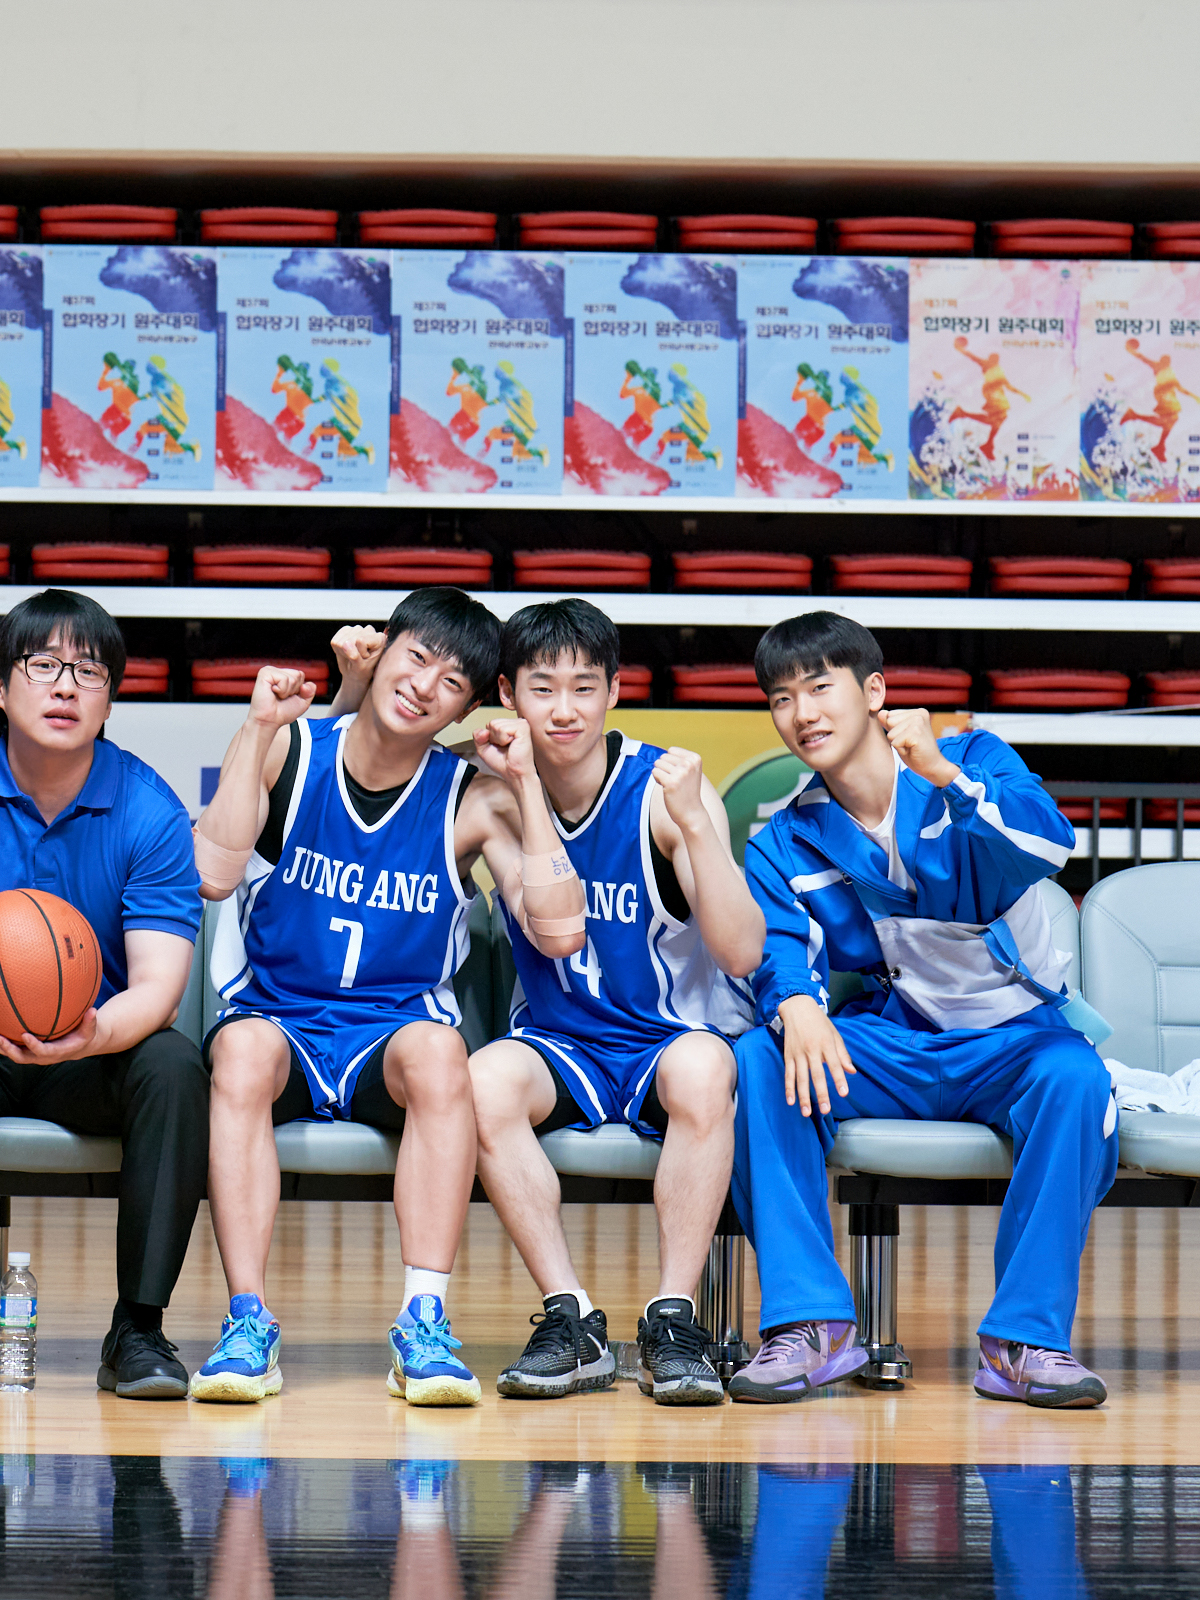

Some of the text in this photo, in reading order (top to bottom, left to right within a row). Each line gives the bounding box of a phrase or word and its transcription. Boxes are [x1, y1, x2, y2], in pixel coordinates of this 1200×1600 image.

[134, 312, 201, 330] 원주대회
[308, 314, 375, 333] 원주대회
[484, 318, 550, 336] 원주대회
[655, 320, 722, 337] 원주대회
[998, 316, 1065, 334] 원주대회
[827, 323, 892, 340] 원주대회
[282, 846, 439, 914] JUNG ANG
[329, 916, 364, 989] 7
